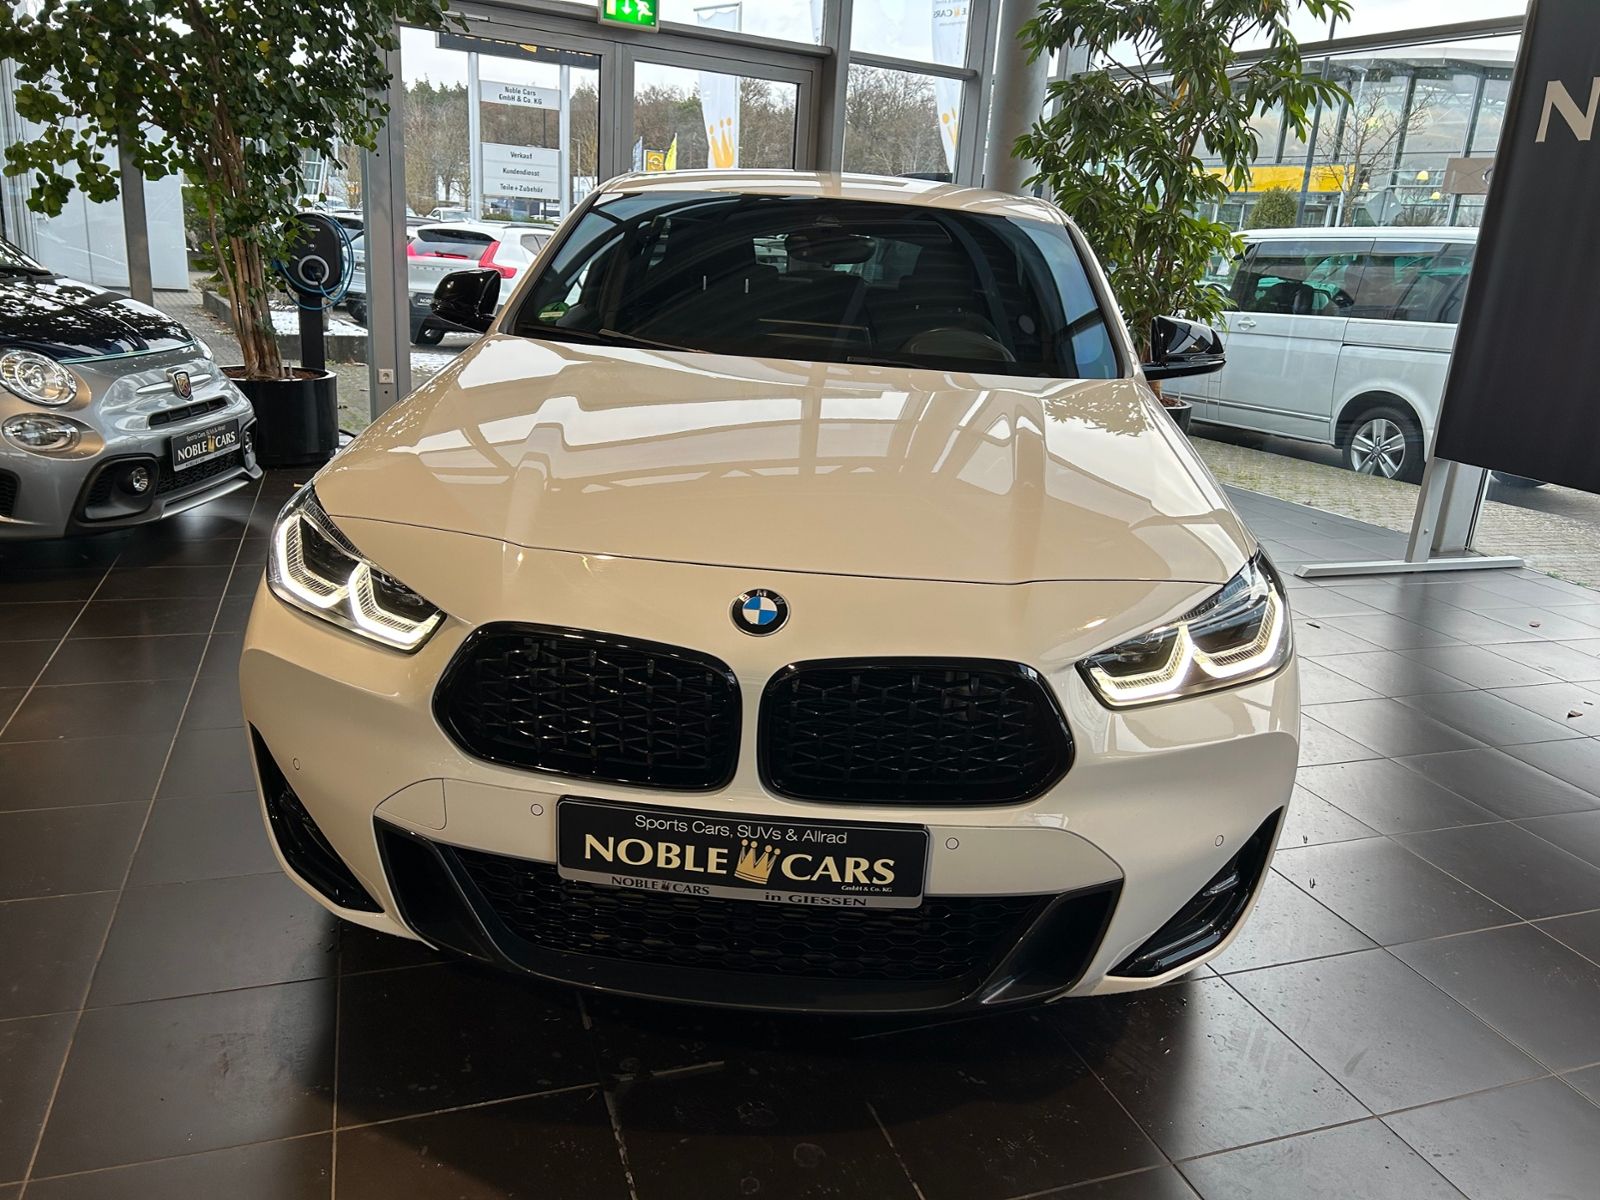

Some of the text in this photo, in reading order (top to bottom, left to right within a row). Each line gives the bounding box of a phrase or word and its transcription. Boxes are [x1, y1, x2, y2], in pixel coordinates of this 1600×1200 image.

[498, 93, 516, 101] GmbH
[505, 86, 521, 94] Noble
[510, 151, 533, 159] Verkauf
[177, 441, 208, 461] NOBLE
[215, 431, 236, 447] CARS
[634, 815, 848, 845] Sports Cars, SUVs & Allrad
[583, 833, 896, 885] NOBLE CARS
[611, 876, 710, 895] NOBLE CARS
[765, 891, 867, 907] in GIESSEN
